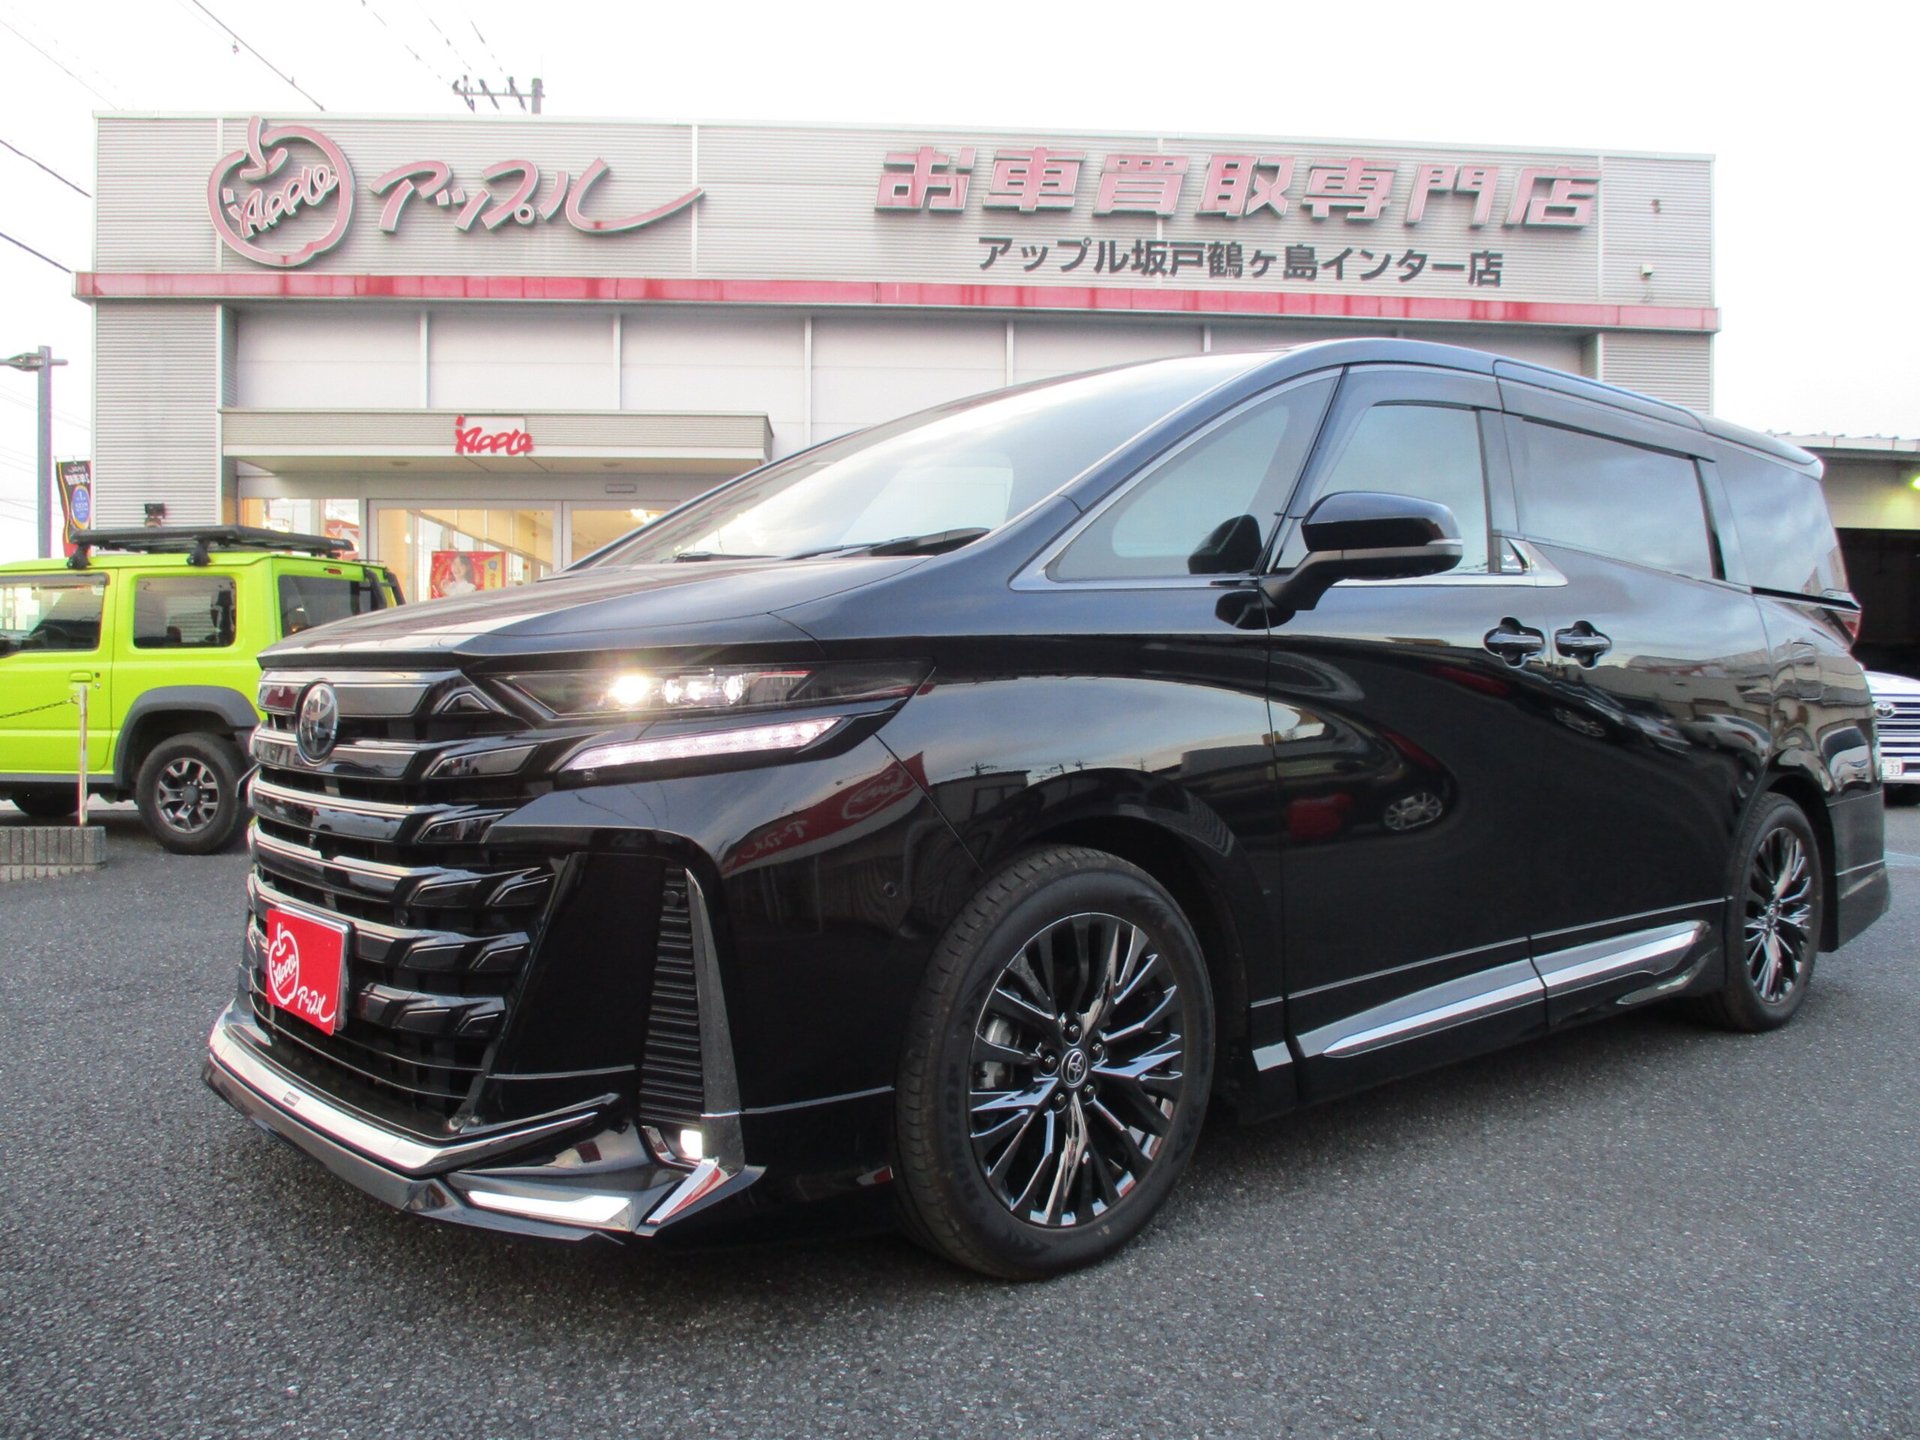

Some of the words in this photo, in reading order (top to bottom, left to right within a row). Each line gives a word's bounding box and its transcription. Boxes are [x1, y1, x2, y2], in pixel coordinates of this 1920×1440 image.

[368, 157, 705, 234] アップル
[874, 145, 1601, 230] お車買取専門店
